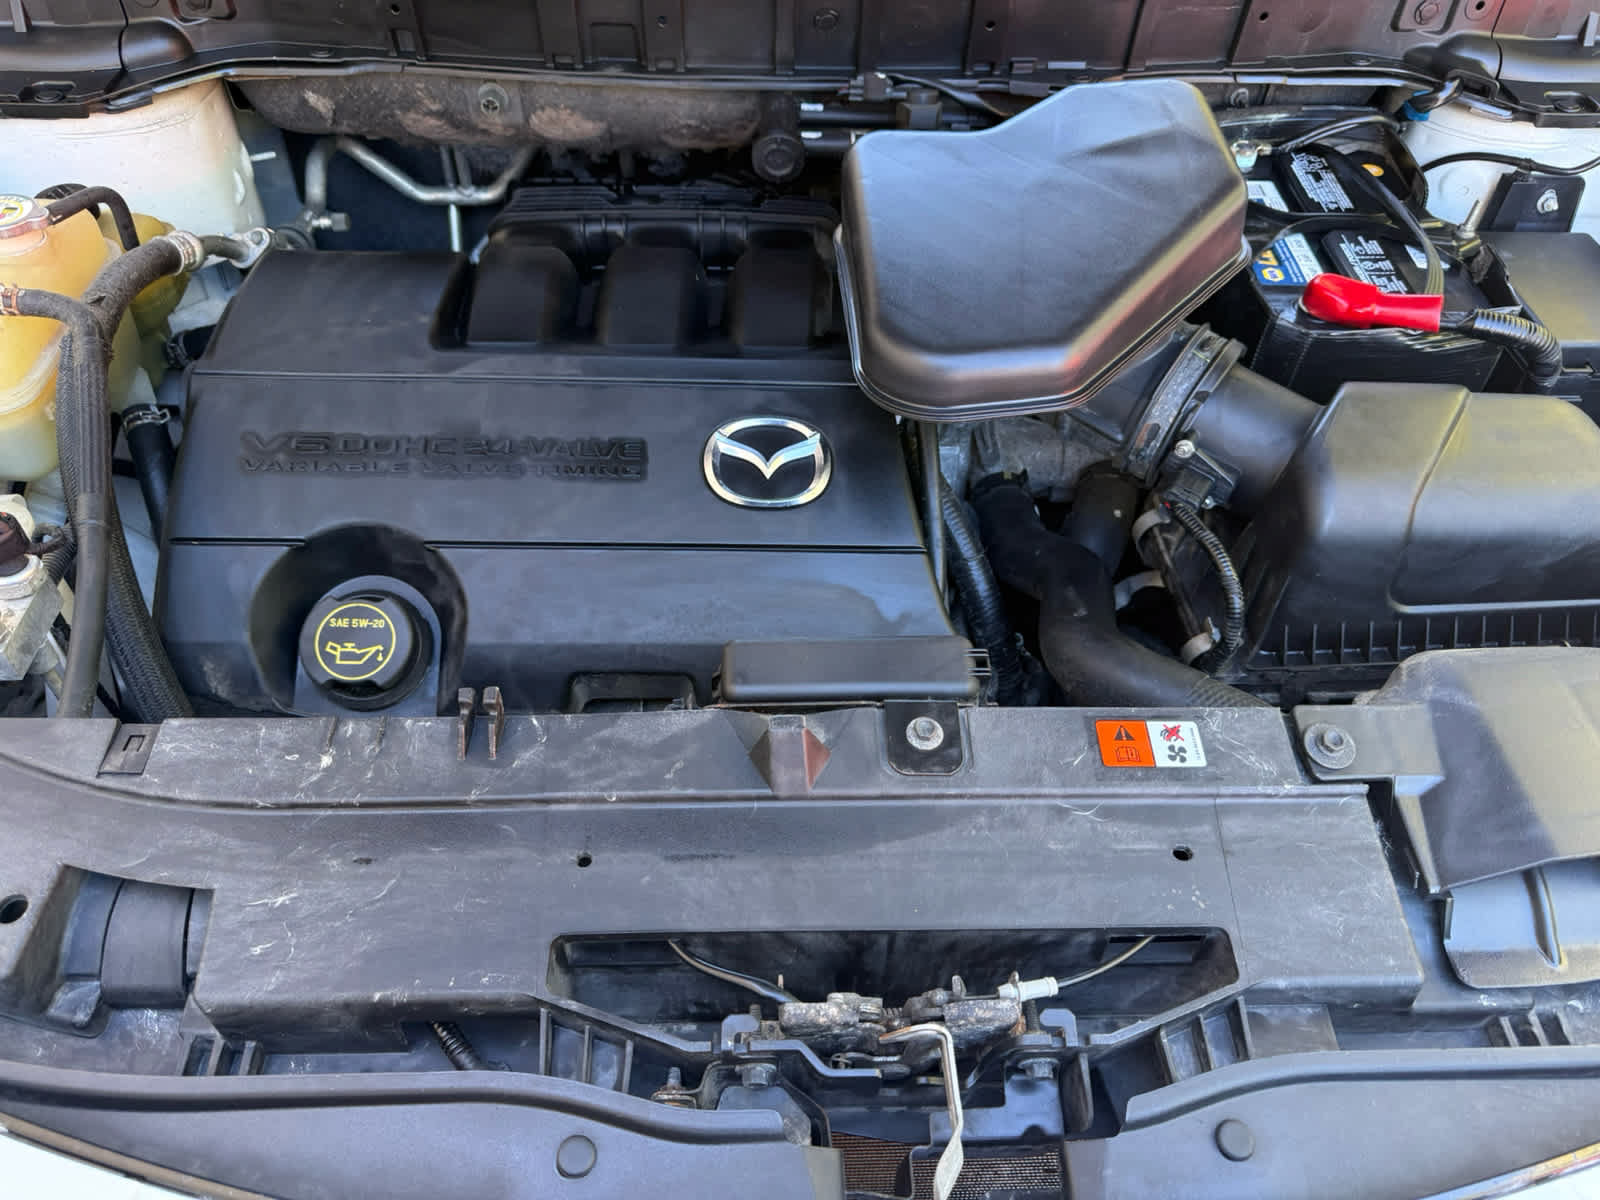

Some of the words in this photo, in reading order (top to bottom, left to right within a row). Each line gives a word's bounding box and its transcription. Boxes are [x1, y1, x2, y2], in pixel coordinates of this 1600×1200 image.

[241, 432, 331, 455] V6
[335, 433, 457, 457] DOHC
[241, 457, 408, 475] VARIABLE
[528, 462, 645, 480] TIMING
[328, 617, 350, 629] SAE
[351, 617, 385, 629] 5W-20
